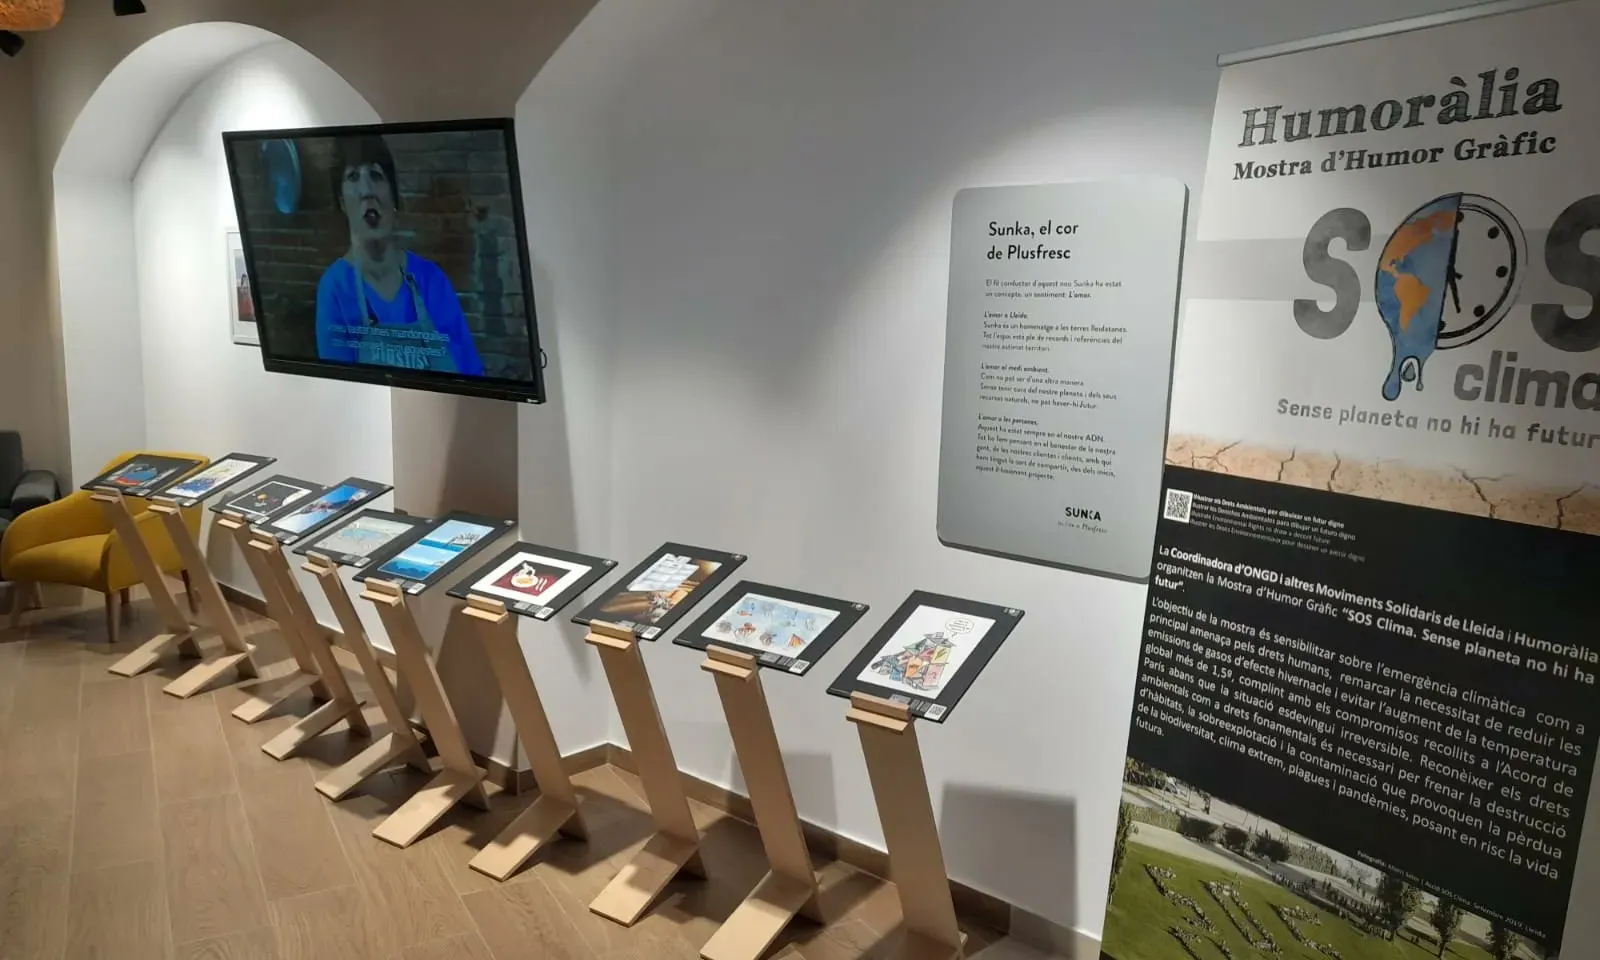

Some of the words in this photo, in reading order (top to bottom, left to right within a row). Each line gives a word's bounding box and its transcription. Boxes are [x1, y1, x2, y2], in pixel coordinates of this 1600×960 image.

[1233, 157, 1312, 181] Mostra
[1321, 145, 1444, 173] d'Humor
[1454, 131, 1557, 161] Gràfic
[1238, 67, 1563, 148] Humoràlia
[987, 245, 1003, 260] de
[1008, 244, 1071, 260] Plusfresc
[989, 220, 1035, 239] Sunka,
[1040, 219, 1052, 235] el
[1056, 224, 1079, 235] cor
[1277, 398, 1333, 420] Sense
[1338, 404, 1419, 429] planeta
[1427, 415, 1452, 433] no
[1460, 415, 1481, 435] hi
[1488, 418, 1517, 439] ha
[1156, 561, 1204, 581] organitzen
[1205, 571, 1215, 585] la
[1216, 574, 1253, 595] Mostra
[1305, 597, 1338, 618] Gràfic
[1375, 616, 1417, 638] Clima.
[1421, 627, 1461, 650] Sense
[1464, 641, 1521, 666] planeta
[1525, 658, 1547, 672] no
[1552, 660, 1569, 678] hi
[1573, 666, 1595, 685] ha
[1158, 544, 1170, 557] La
[1169, 546, 1233, 573] Coordinadora
[1283, 575, 1315, 593] altres
[1315, 582, 1384, 610] Moviments
[1384, 599, 1442, 625] Solidaris
[1442, 614, 1461, 630] de
[1461, 618, 1505, 641] Lleida
[1513, 631, 1599, 664] Humoràlia
[1135, 715, 1165, 737] futura.
[1144, 642, 1173, 659] global
[1174, 653, 1194, 667] més
[1196, 659, 1209, 673] de
[1238, 675, 1285, 699] complint
[1287, 691, 1312, 708] amb
[1314, 700, 1331, 715] els
[1334, 708, 1419, 745] compromisos
[1423, 738, 1476, 765] recollits
[1480, 758, 1489, 770] a
[1552, 780, 1574, 798] de
[1147, 628, 1191, 650] emissions
[1191, 641, 1204, 654] de
[1204, 647, 1232, 664] gasos
[1276, 667, 1332, 697] hivernacle
[1340, 691, 1376, 710] evitar
[1444, 723, 1462, 740] de
[1464, 728, 1477, 745] la
[1480, 735, 1577, 777] temperatura
[1148, 613, 1189, 632] principal
[1188, 625, 1232, 647] amenaça
[1232, 639, 1255, 654] pels
[1257, 644, 1285, 663] drets
[1286, 652, 1332, 681] humans,
[1339, 672, 1397, 698] remarcar
[1399, 687, 1411, 703] la
[1414, 695, 1481, 726] necessitat
[1484, 715, 1503, 732] de
[1507, 725, 1555, 747] reduir
[1559, 735, 1582, 756] les
[1195, 609, 1208, 622] de
[1208, 611, 1218, 626] la
[1219, 618, 1256, 637] mostra
[1258, 627, 1271, 641] és
[1273, 633, 1336, 661] sensibilitzar
[1338, 653, 1373, 672] sobre
[1461, 688, 1526, 718] climàtica
[1535, 711, 1570, 731] com
[1575, 723, 1585, 735] a
[1136, 701, 1150, 715] de
[1149, 705, 1159, 718] la
[1159, 709, 1217, 744] biodiversitat,
[1217, 734, 1246, 754] clima
[1247, 746, 1286, 772] extrem,
[1287, 763, 1330, 789] plagues
[1337, 783, 1409, 822] pandèmies,
[1411, 813, 1457, 840] posant
[1459, 833, 1477, 848] en
[1480, 840, 1506, 859] risc
[1508, 848, 1522, 865] la
[1525, 857, 1559, 880] vida
[1140, 673, 1189, 698] ambientals
[1190, 691, 1212, 707] com
[1213, 700, 1220, 710] a
[1222, 702, 1250, 721] drets
[1252, 711, 1317, 747] fonamentals
[1319, 737, 1333, 753] és
[1336, 746, 1395, 775] necessari
[1397, 768, 1421, 784] per
[1424, 775, 1465, 801] frenar
[1468, 791, 1481, 808] la
[1485, 800, 1567, 839] destrucció
[1143, 656, 1165, 673] París
[1168, 666, 1195, 684] abans
[1197, 677, 1216, 692] que
[1219, 682, 1230, 697] la
[1233, 689, 1274, 712] situació
[1277, 705, 1336, 735] esdevingui
[1339, 725, 1413, 763] irreversible.
[1419, 753, 1494, 791] Reconèixer
[1500, 785, 1521, 801] els
[1528, 794, 1570, 818] drets
[1187, 704, 1196, 718] la
[1197, 710, 1277, 748] sobreexplotació
[1286, 741, 1296, 756] la
[1298, 750, 1378, 788] contaminació
[1381, 781, 1407, 799] que
[1409, 792, 1483, 830] provoquen
[1487, 819, 1501, 837] la
[1505, 830, 1562, 860] pèrdua
